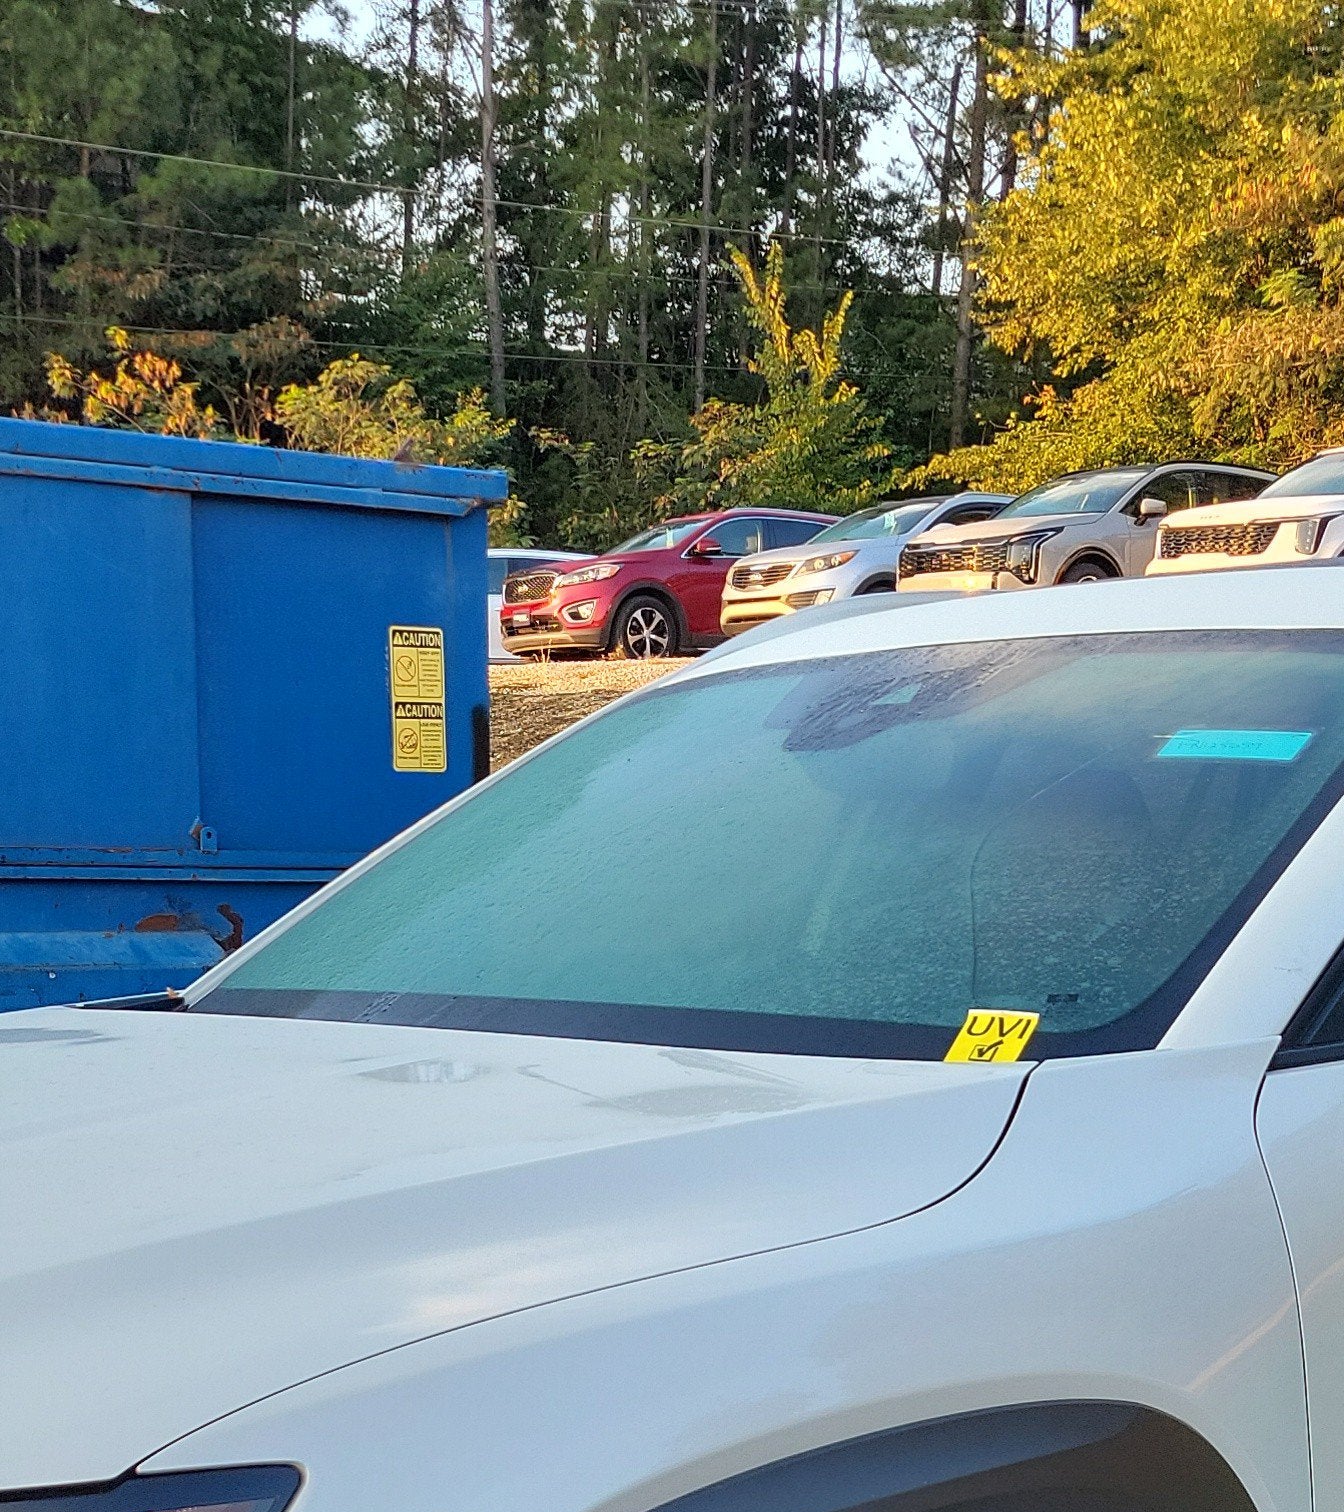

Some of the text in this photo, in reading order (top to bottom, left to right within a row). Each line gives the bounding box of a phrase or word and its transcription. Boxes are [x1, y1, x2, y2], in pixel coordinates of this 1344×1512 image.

[402, 632, 441, 647] CAUTION
[406, 704, 443, 718] CAUTION
[966, 1016, 1031, 1039] UVI
